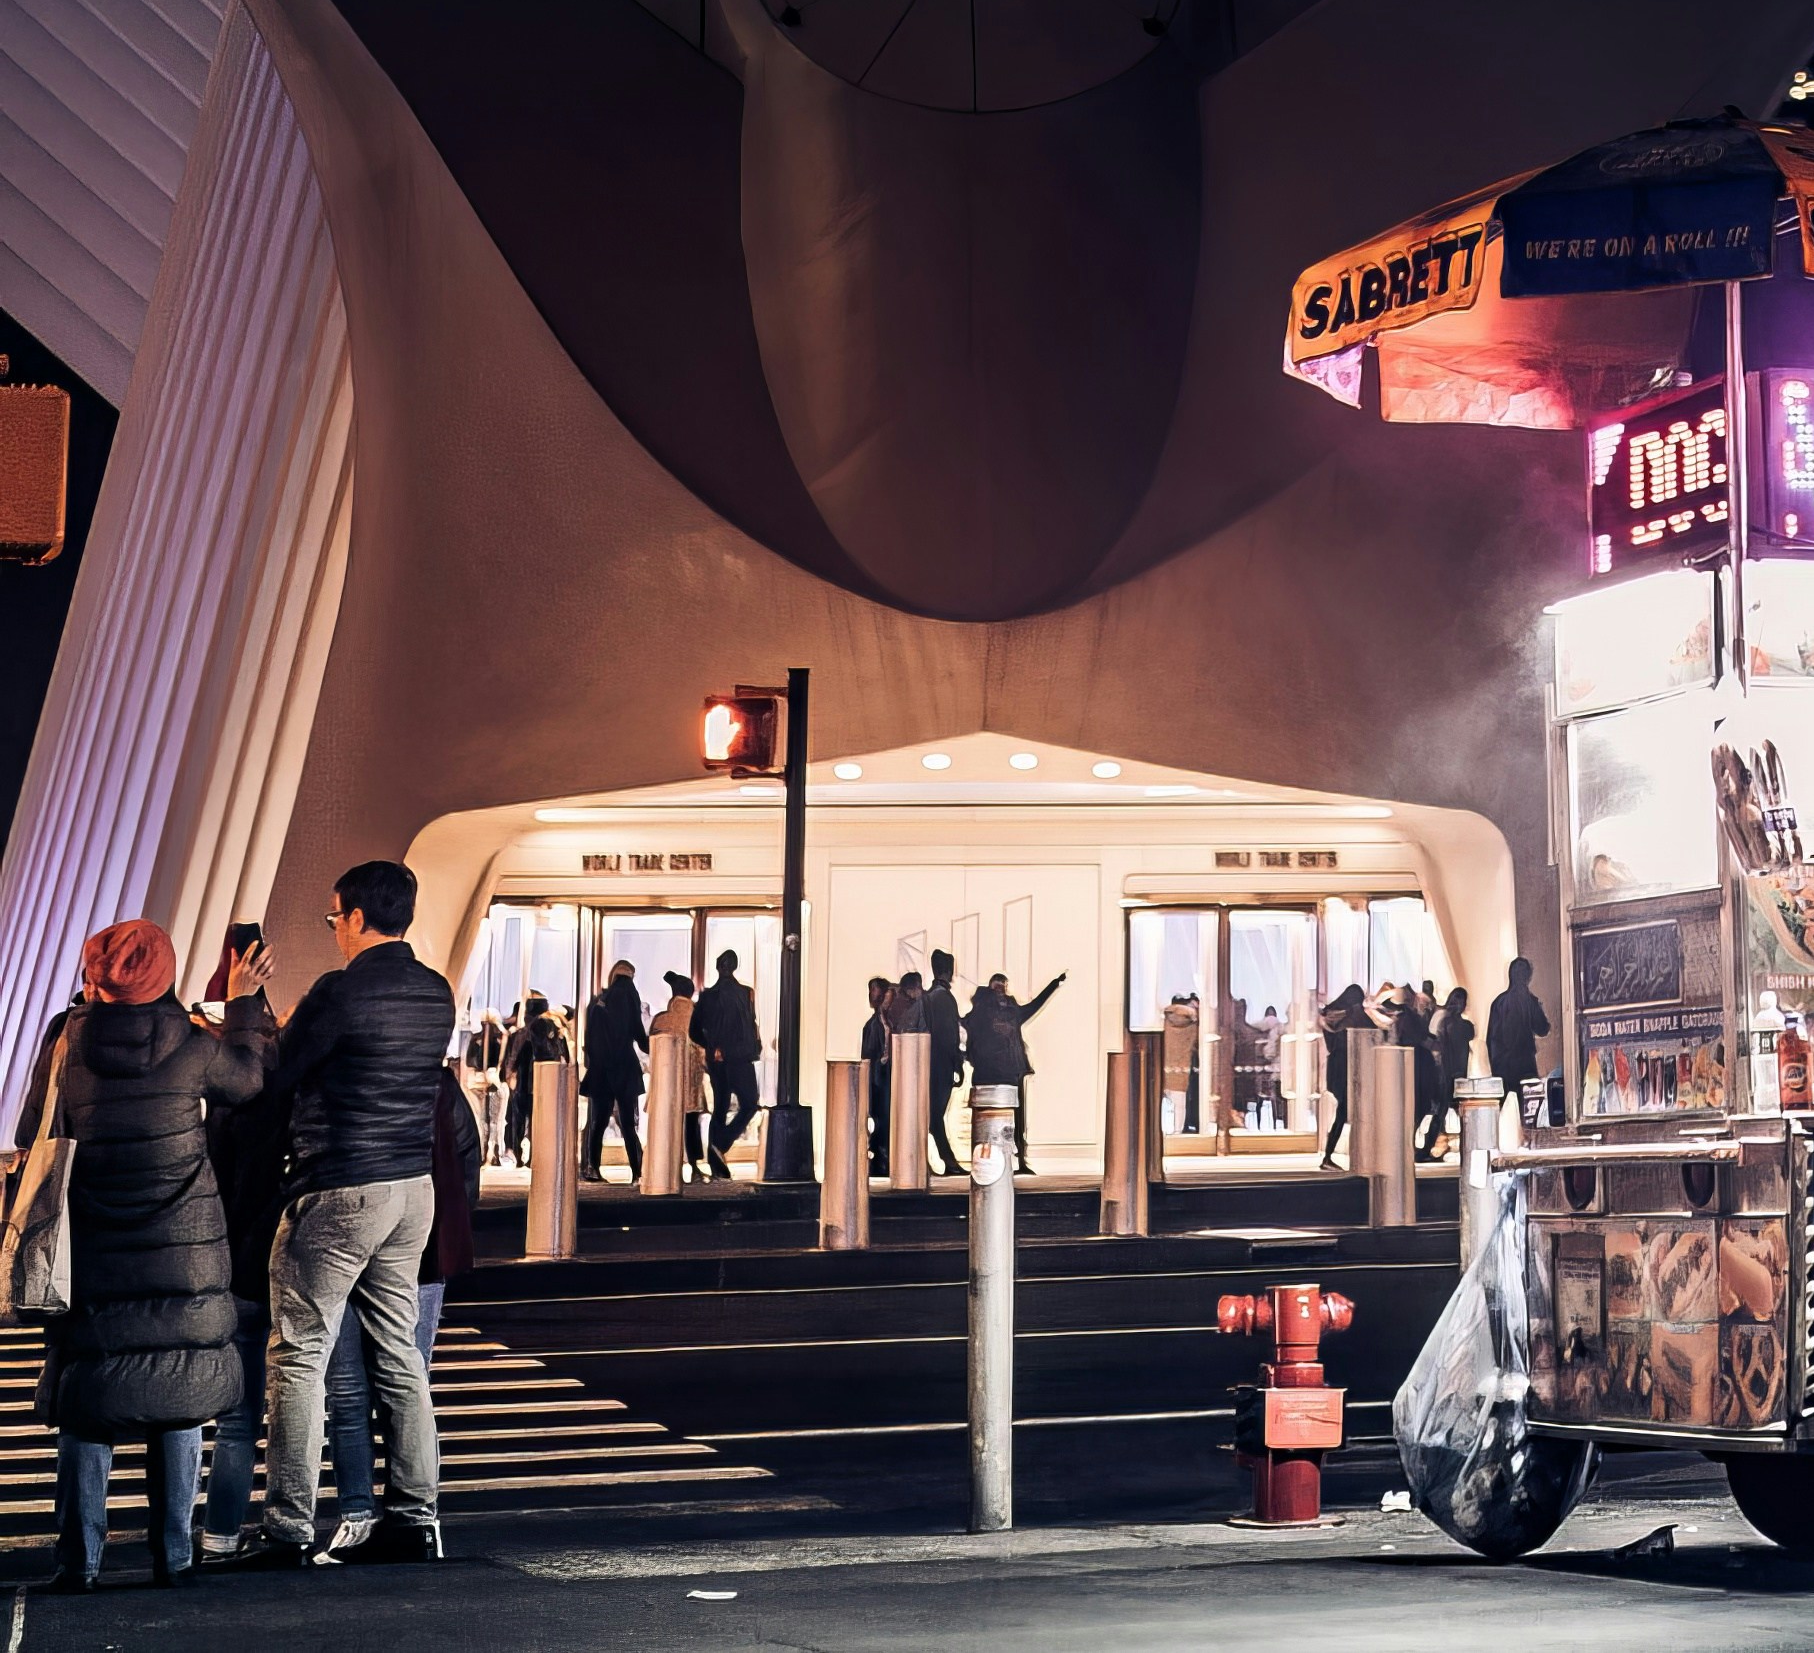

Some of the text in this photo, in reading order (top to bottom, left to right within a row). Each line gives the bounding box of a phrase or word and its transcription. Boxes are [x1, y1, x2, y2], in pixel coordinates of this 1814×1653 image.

[1604, 237, 1634, 257] ON
[1643, 234, 1657, 256] A
[1665, 229, 1716, 254] ROLL
[1300, 222, 1484, 339] SABRETT
